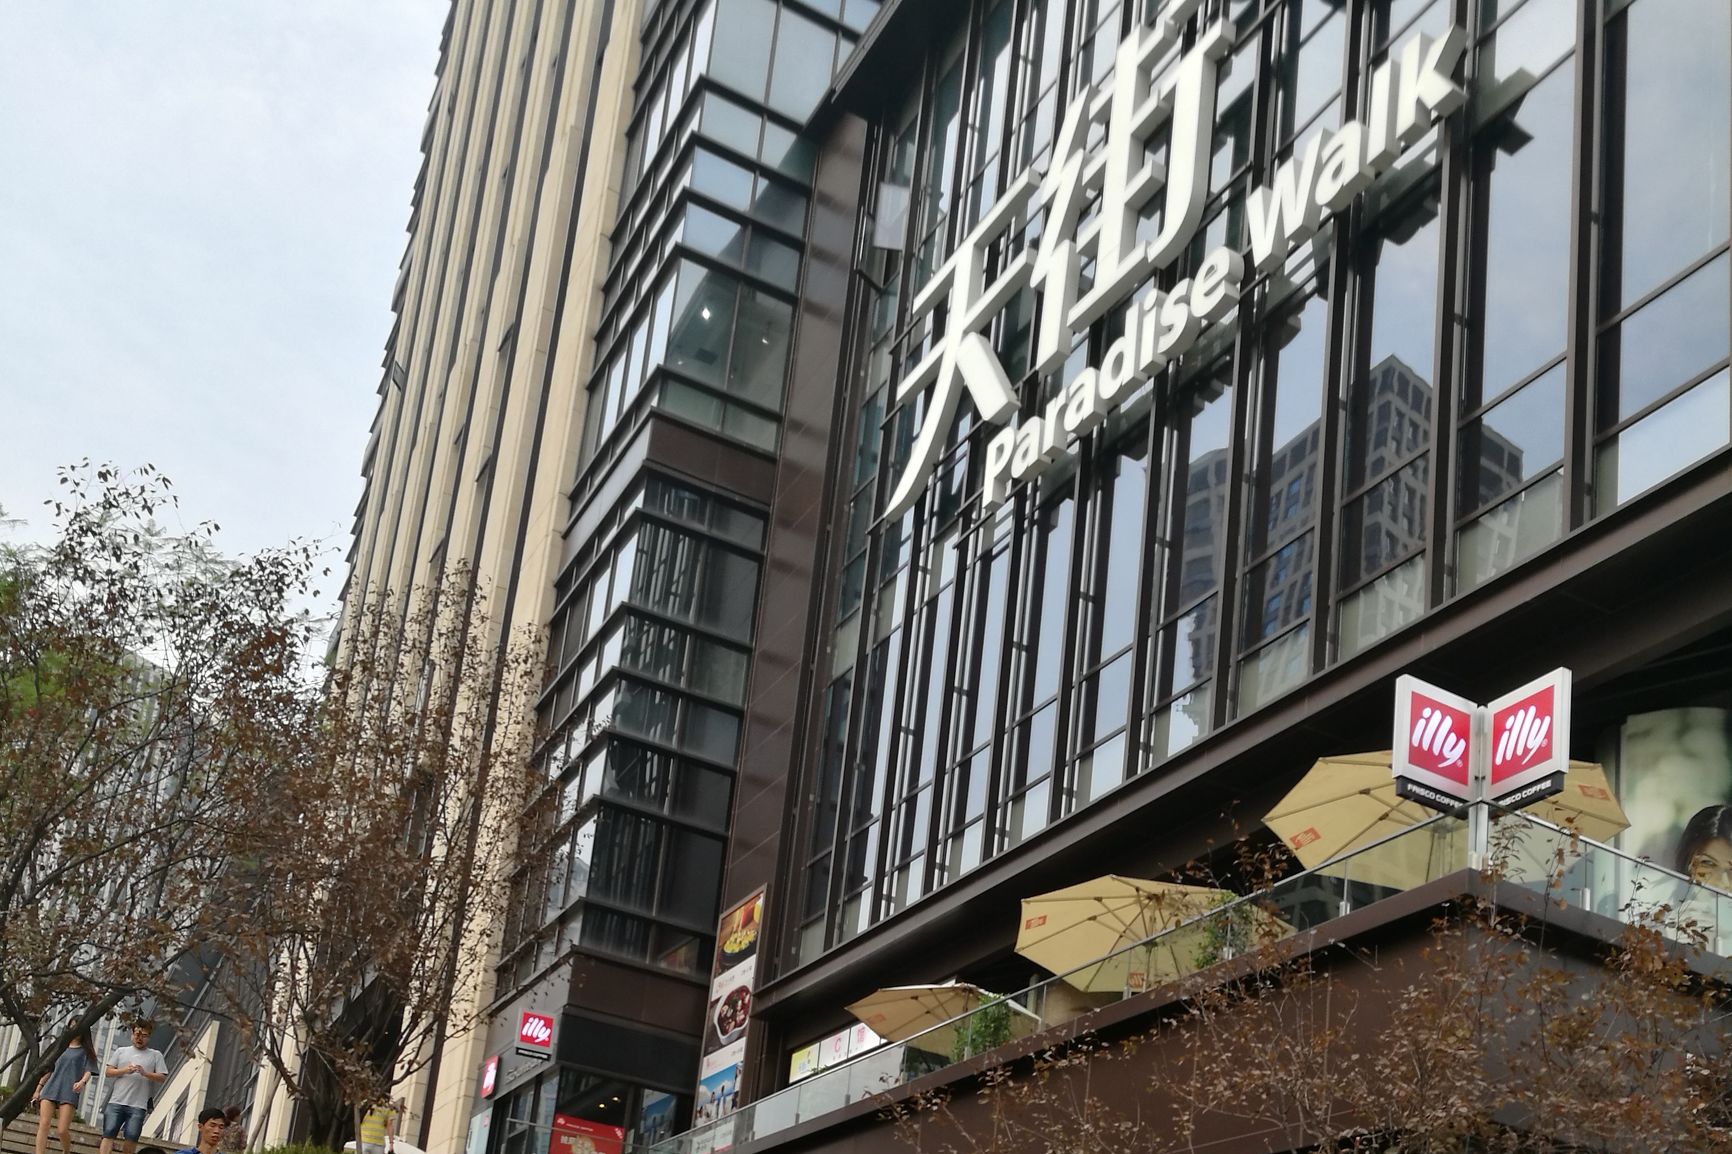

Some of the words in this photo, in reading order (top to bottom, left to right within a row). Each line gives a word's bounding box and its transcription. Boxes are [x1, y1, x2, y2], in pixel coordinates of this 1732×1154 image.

[883, 0, 1236, 520] 天街
[981, 246, 1245, 512] Paradise
[1246, 24, 1468, 274] Walk
[1411, 706, 1467, 768] illy
[1495, 705, 1552, 766] illy
[1407, 783, 1436, 800] FRISCO
[1522, 779, 1552, 799] COFFEE
[521, 1017, 552, 1043] illy
